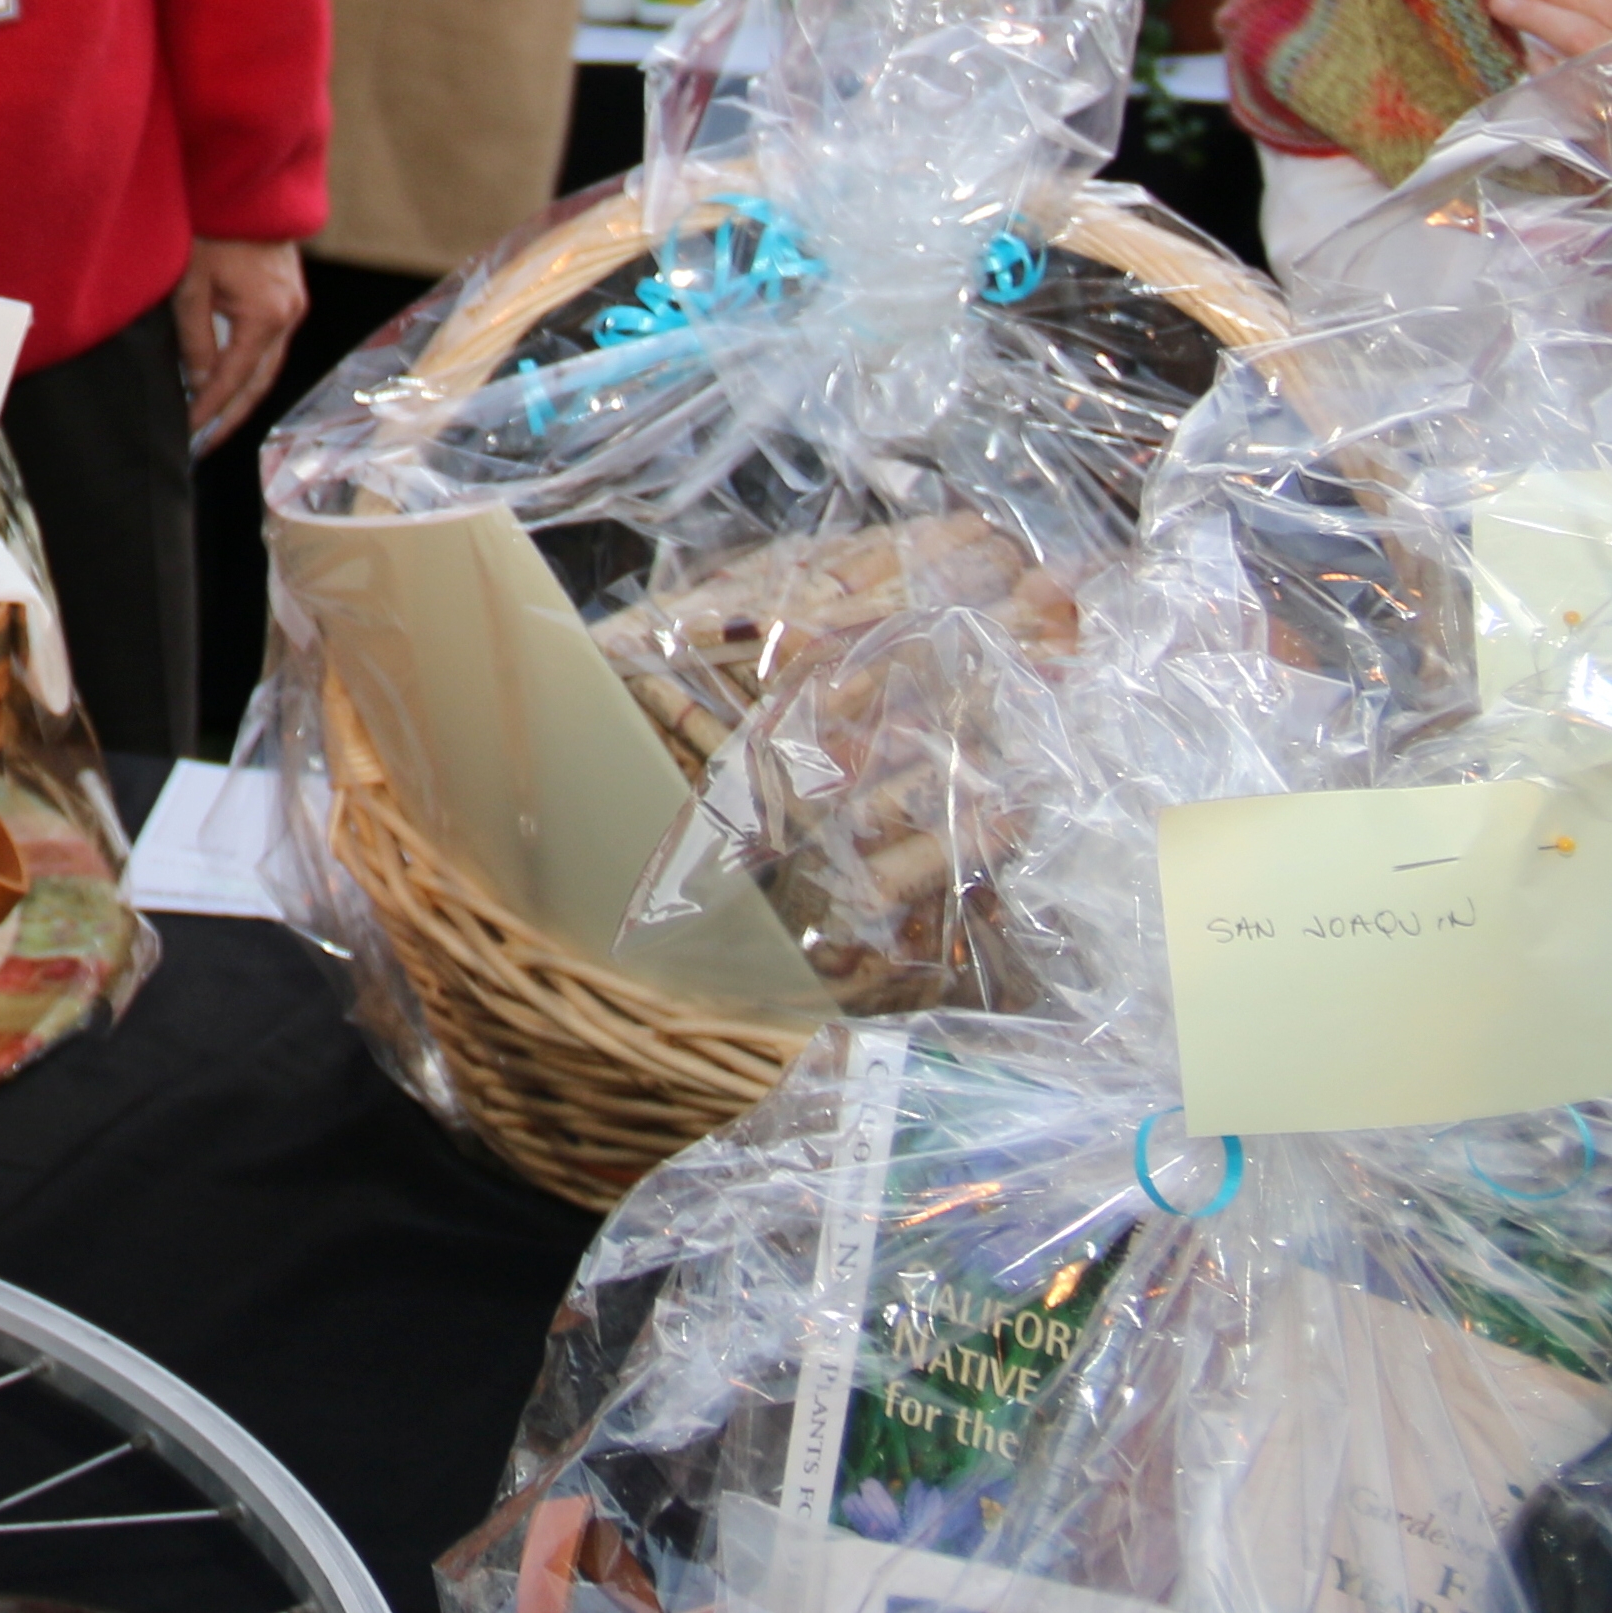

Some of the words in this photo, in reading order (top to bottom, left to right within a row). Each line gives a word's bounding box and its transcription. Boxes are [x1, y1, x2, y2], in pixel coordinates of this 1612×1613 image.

[1207, 916, 1276, 944] SAN
[1302, 896, 1476, 941] JOAQUIN
[903, 1262, 1083, 1361] CALIFOR
[892, 1314, 1041, 1407] NATIVE
[884, 1379, 943, 1433] for
[953, 1405, 1021, 1462] the
